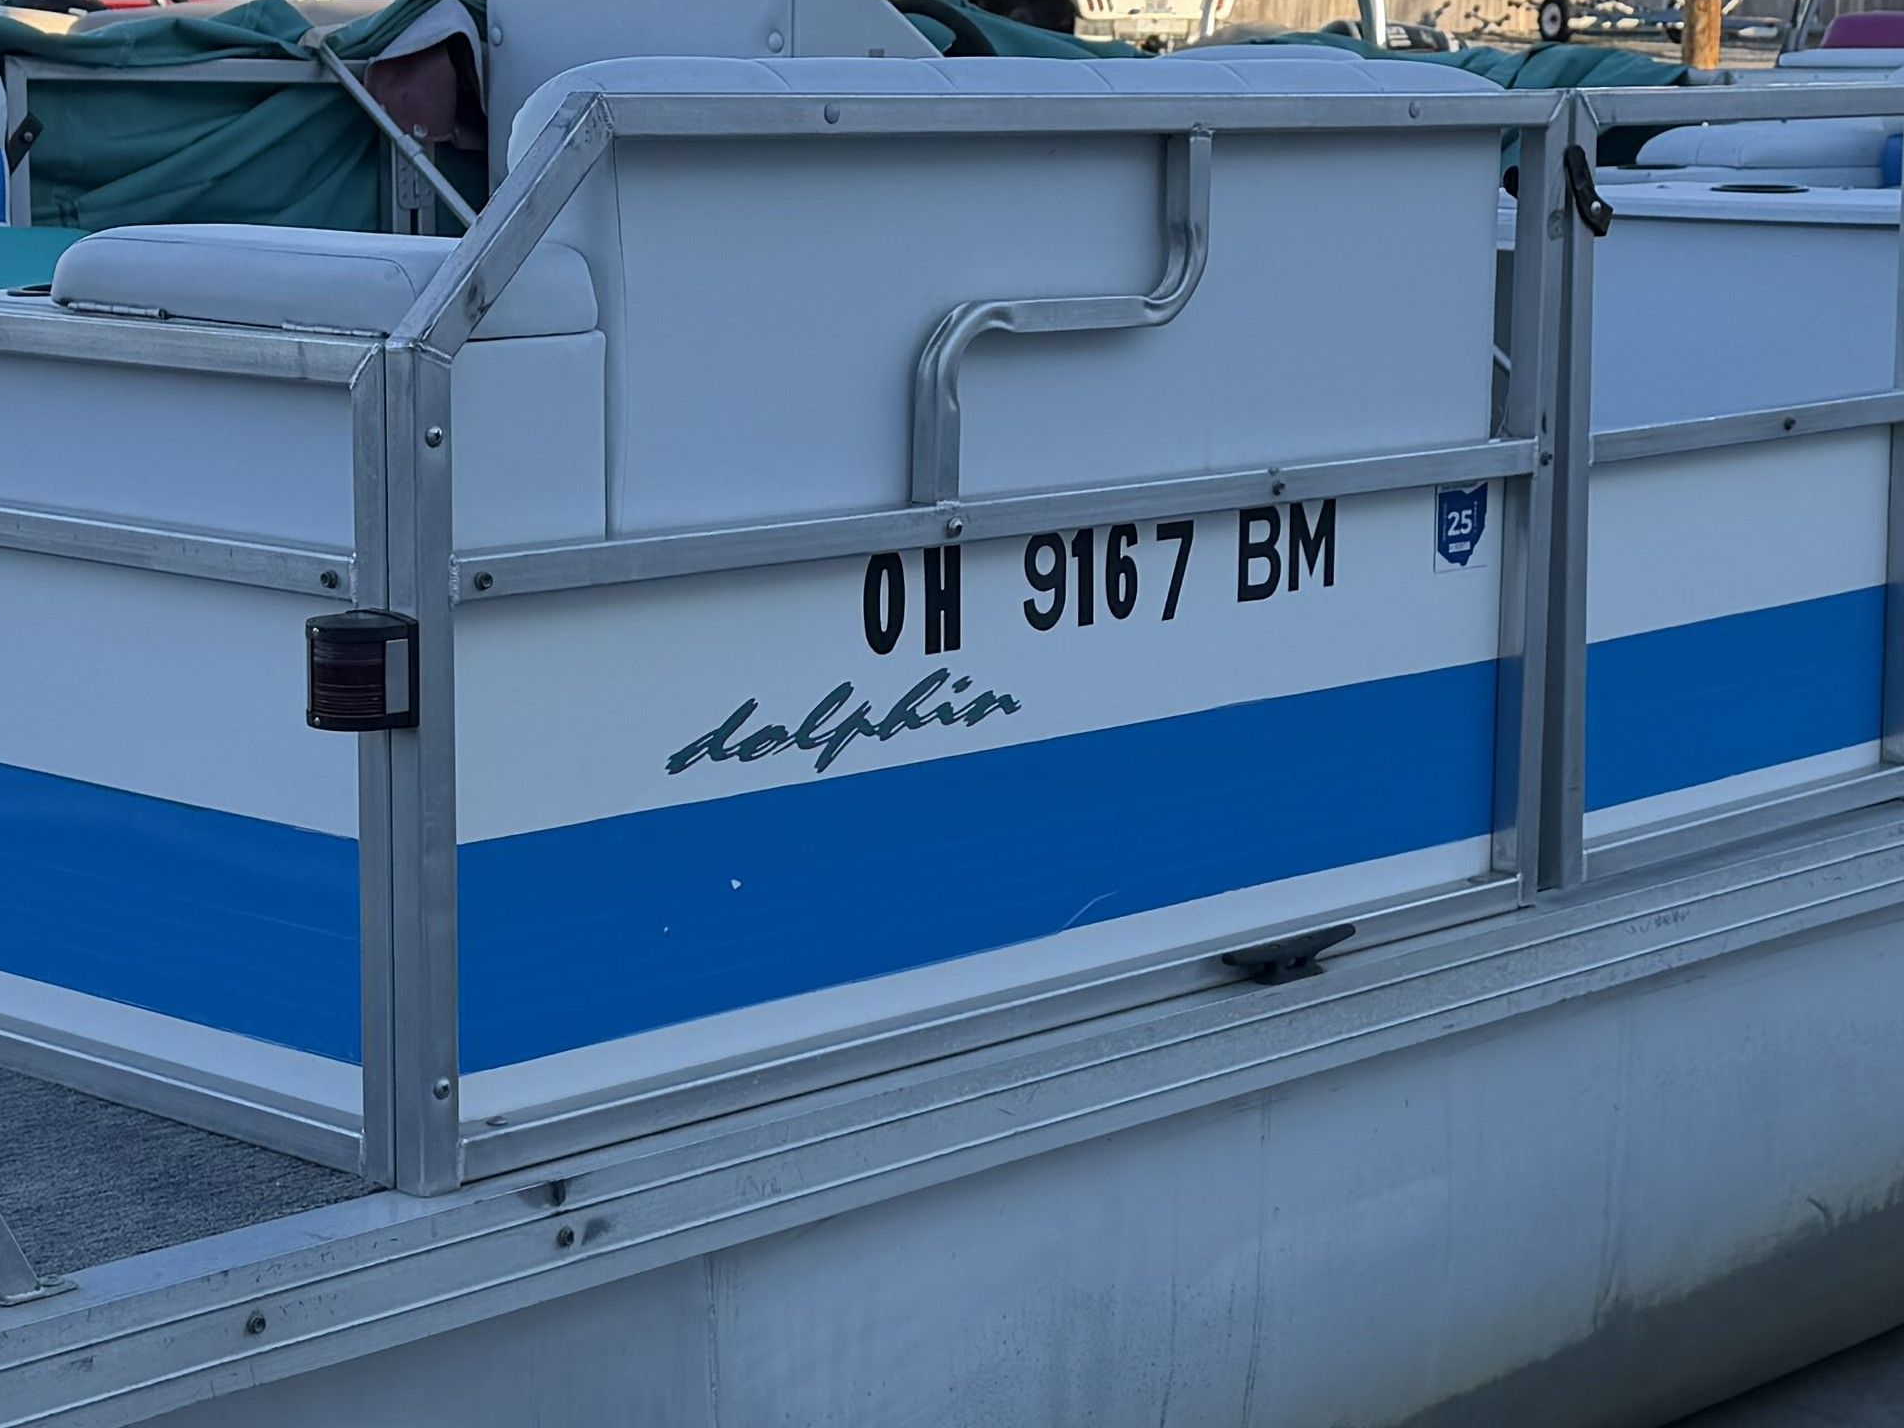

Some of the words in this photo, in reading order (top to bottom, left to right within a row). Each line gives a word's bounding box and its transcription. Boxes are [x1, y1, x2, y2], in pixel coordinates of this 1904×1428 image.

[863, 544, 961, 655] OH
[1023, 519, 1194, 631] 9167
[1237, 498, 1336, 603] BM
[1447, 509, 1473, 537] 25
[665, 667, 1021, 775] dolphin
